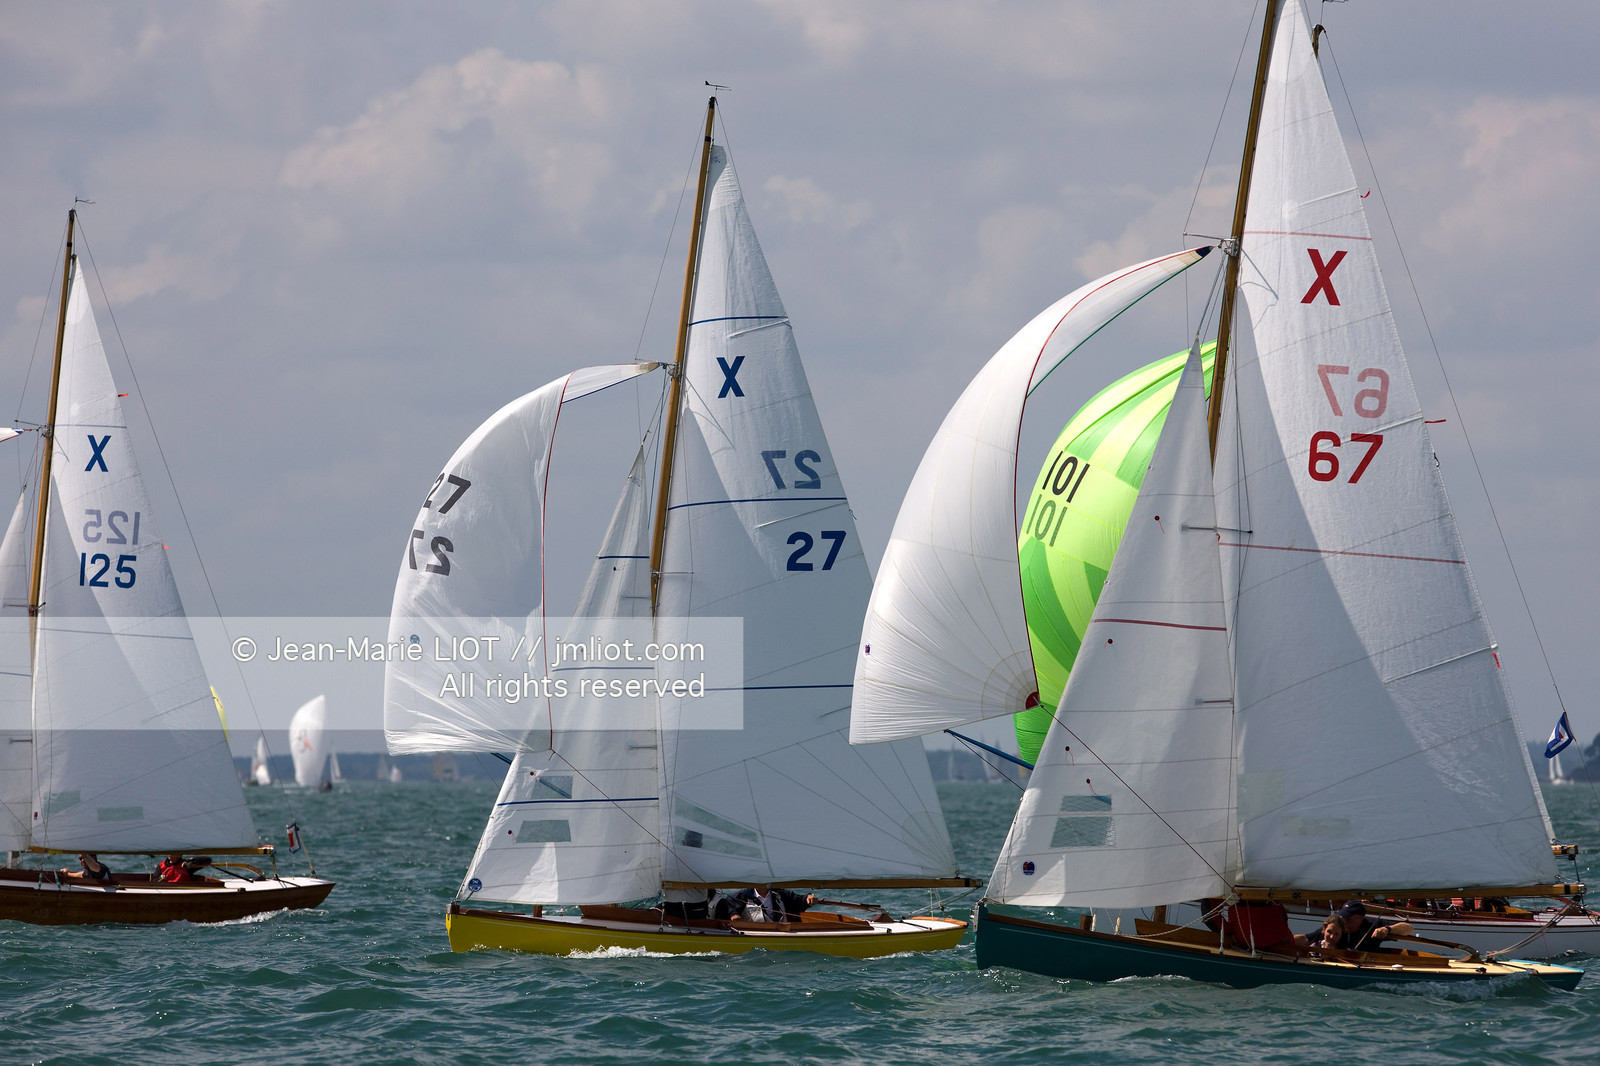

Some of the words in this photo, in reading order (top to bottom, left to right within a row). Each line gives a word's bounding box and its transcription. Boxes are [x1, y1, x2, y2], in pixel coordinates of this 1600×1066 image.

[1300, 248, 1348, 306] X
[716, 355, 746, 399] X
[84, 434, 112, 472] X
[1308, 430, 1384, 484] 67
[423, 472, 472, 515] 27
[1041, 450, 1091, 504] 101
[79, 552, 137, 589] 125
[786, 530, 847, 572] 27
